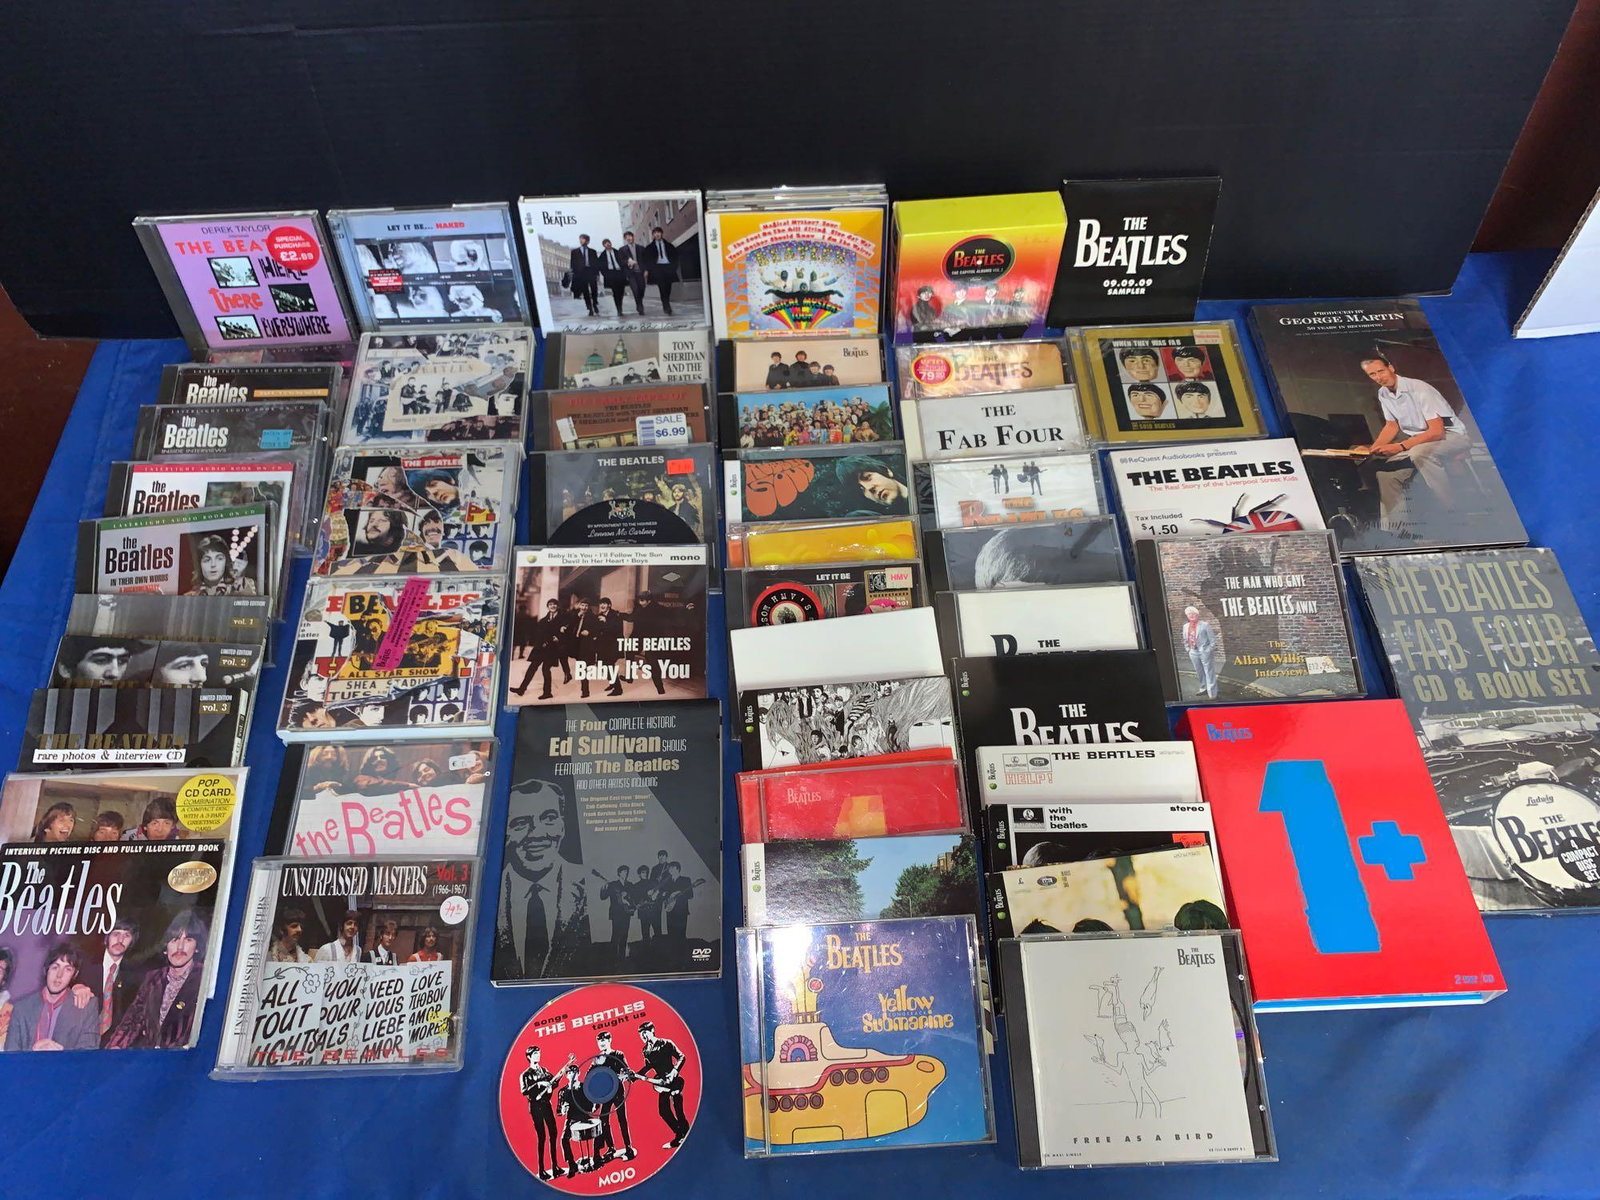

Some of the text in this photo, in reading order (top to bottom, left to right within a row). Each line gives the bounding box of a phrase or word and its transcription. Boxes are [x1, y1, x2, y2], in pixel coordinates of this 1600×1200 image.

[201, 225, 271, 235] DEREK TAYLOR
[1123, 217, 1149, 231] THE
[1073, 218, 1189, 274] BEATLES
[1103, 278, 1153, 288] 09.09.09
[1107, 287, 1146, 296] SAMPLER
[1279, 312, 1405, 327] GEORGE MARTIN
[672, 341, 696, 351] TONY
[662, 352, 706, 362] SHERIDAN
[666, 362, 703, 373] AND THE
[667, 374, 703, 383] BEATLES
[981, 405, 1016, 418] THE
[181, 415, 197, 428] the
[656, 415, 682, 424] SALE
[163, 423, 229, 449] Beatles
[655, 427, 686, 438] $6.99
[937, 424, 1064, 450] FAB FOUR
[598, 456, 665, 467] THE BEATLES
[1128, 450, 1238, 464] ReQuest Audiobooks presents
[1126, 461, 1295, 486] THE BEATLES
[152, 480, 167, 493] the
[1148, 484, 1163, 492] The
[1164, 483, 1181, 491] Real
[1181, 482, 1201, 491] Story
[1212, 480, 1224, 488] the
[1225, 478, 1259, 487] Liverpool
[1282, 475, 1299, 483] Kids
[113, 518, 166, 529] LASERLIGHT
[171, 515, 198, 524] AUDIO
[122, 536, 138, 550] the
[105, 544, 174, 575] Beatles
[110, 573, 169, 587] IN THEIR OWN WORDS
[1224, 574, 1307, 590] THE MAN WHO GAVE
[1378, 559, 1554, 616] THE BEATLES
[1220, 595, 1318, 617] THE BEATLES AWAY
[617, 637, 691, 651] THE BEATLES
[1037, 639, 1061, 649] THE
[1267, 640, 1287, 648] The
[1393, 613, 1580, 672] FAB FOUR
[222, 658, 247, 666] vol. 2
[348, 668, 440, 679] ALL STAR SHOW
[575, 659, 690, 684] Baby It's You
[1255, 668, 1308, 678] Interviews
[1412, 668, 1593, 703] CD & BOOK SET
[202, 704, 227, 712] vol. 3
[1059, 703, 1087, 719] THE
[565, 716, 676, 732] THE Four COMPLETE HISTORIC
[549, 735, 687, 757] Ed Sullivan SHOWS
[36, 750, 183, 763] rare photos & interview CD
[1051, 752, 1081, 761] THE
[1087, 749, 1156, 760] BEATLES
[554, 757, 680, 776] FEATURING The Beatles
[198, 779, 220, 788] POP
[185, 788, 231, 797] CD CARD
[1169, 805, 1205, 813] stereo
[341, 789, 473, 860] Beatles
[1050, 821, 1088, 830] beatles
[1539, 814, 1567, 825] THE
[295, 818, 339, 858] the
[4, 844, 220, 856] INTERVIEW PICTURE DISC AND FULLY ILLUSTRATED BOOK
[1258, 759, 1428, 954] 1+
[1560, 846, 1599, 864] COMPACT
[24, 861, 46, 885] The
[282, 865, 428, 897] UNSURPASSED MASTERS
[0, 860, 123, 936] Beatles
[855, 932, 871, 942] THE
[692, 948, 712, 957] DVD
[826, 934, 903, 974] BEATLES
[1177, 948, 1216, 968] BEATLES
[410, 970, 444, 993] LOVE
[260, 980, 300, 1011] ALL
[877, 985, 935, 1013] Yellow
[365, 996, 404, 1020] VOUS
[252, 1003, 313, 1042] TOUT
[534, 1000, 646, 1038] THE BEATLES
[534, 1013, 569, 1027] songs
[592, 1010, 647, 1031] taught us
[862, 1010, 954, 1034] Submarine
[362, 1013, 406, 1042] LIEBE
[1073, 1136, 1112, 1145] FREE
[1124, 1135, 1143, 1143] AS
[1174, 1133, 1214, 1141] BIRD
[598, 1167, 636, 1188] MOJO
